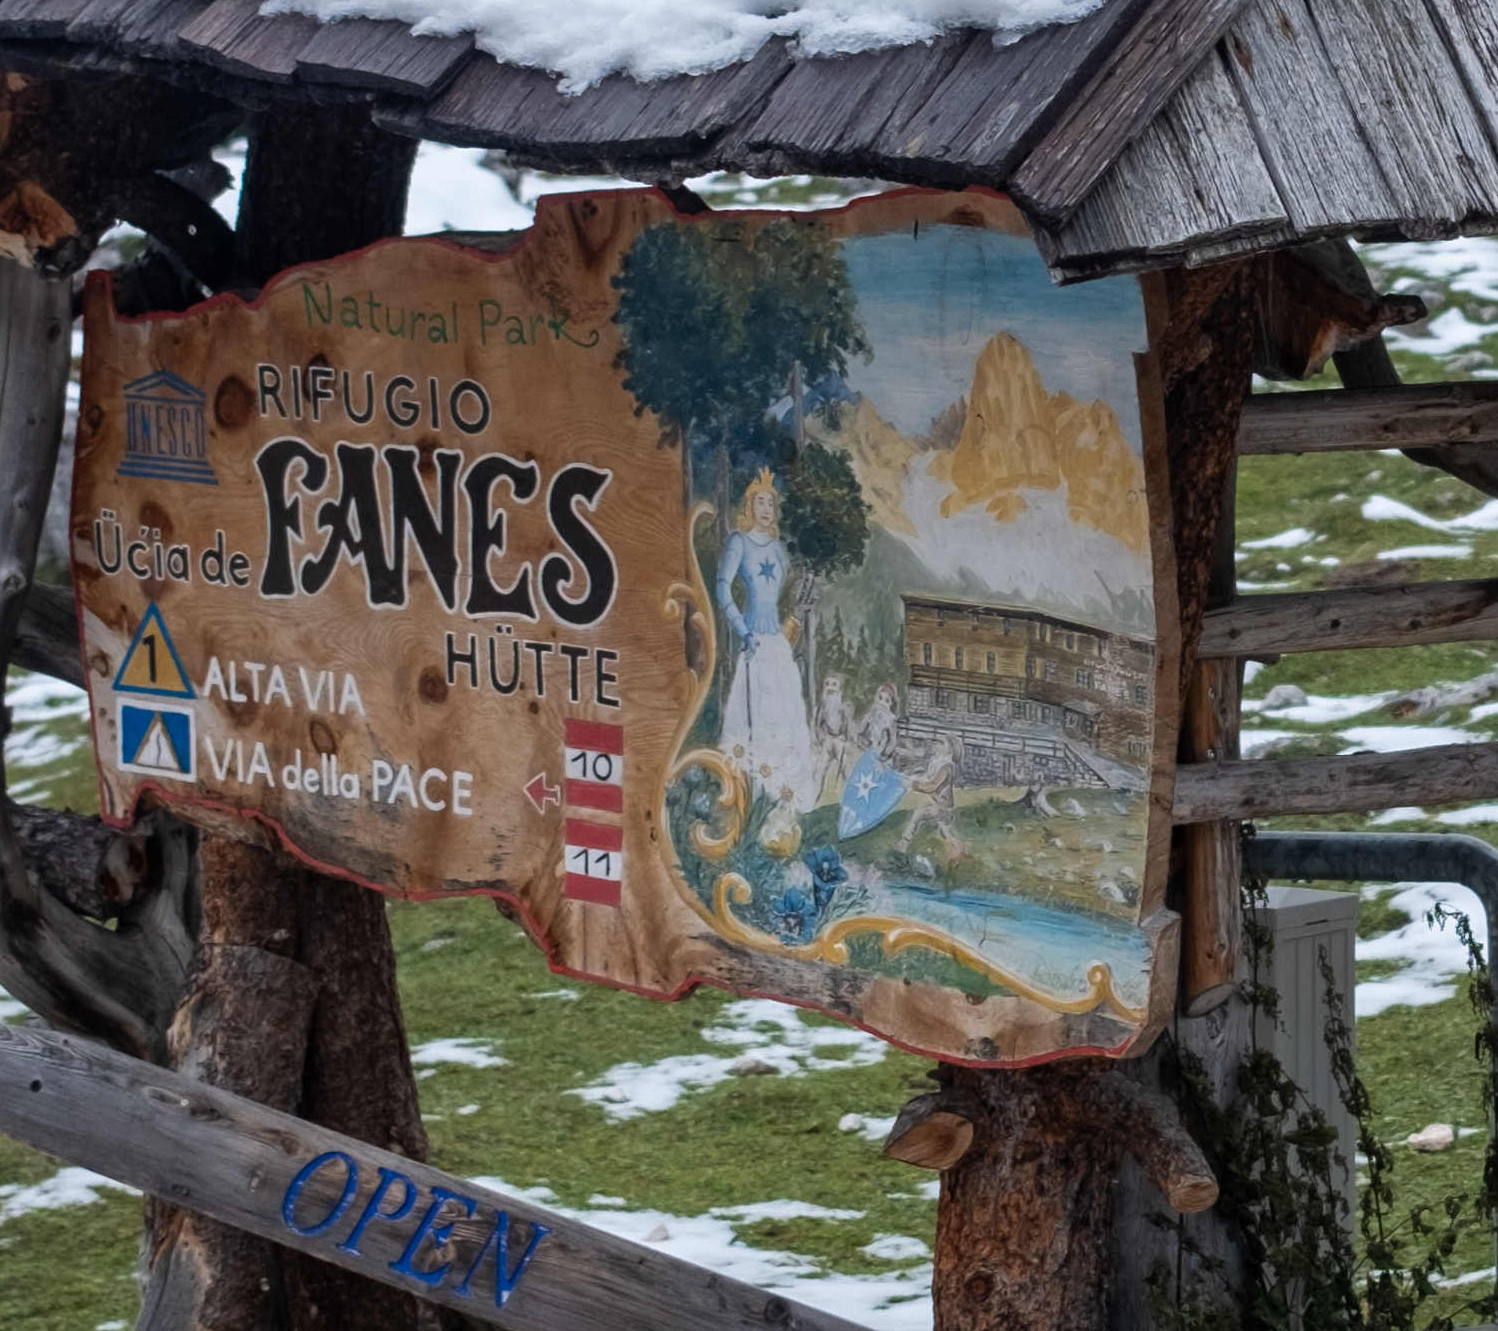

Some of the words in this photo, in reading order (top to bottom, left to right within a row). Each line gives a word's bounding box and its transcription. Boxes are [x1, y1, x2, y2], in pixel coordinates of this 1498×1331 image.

[303, 282, 460, 346] Natural
[479, 294, 601, 350] Park
[127, 402, 206, 458] UNESCO
[256, 364, 491, 435] RIFUGIO
[200, 530, 251, 588] de
[254, 436, 619, 630] FANES
[140, 634, 159, 684] 1
[204, 656, 293, 707] ALTA
[298, 665, 366, 717] VIA
[446, 624, 621, 709] HÜTTE
[205, 737, 276, 788] VIA
[282, 749, 361, 800] della
[373, 758, 474, 816] PACE
[570, 752, 614, 781] 10
[572, 847, 613, 878] 11
[282, 1150, 551, 1309] OPEN
